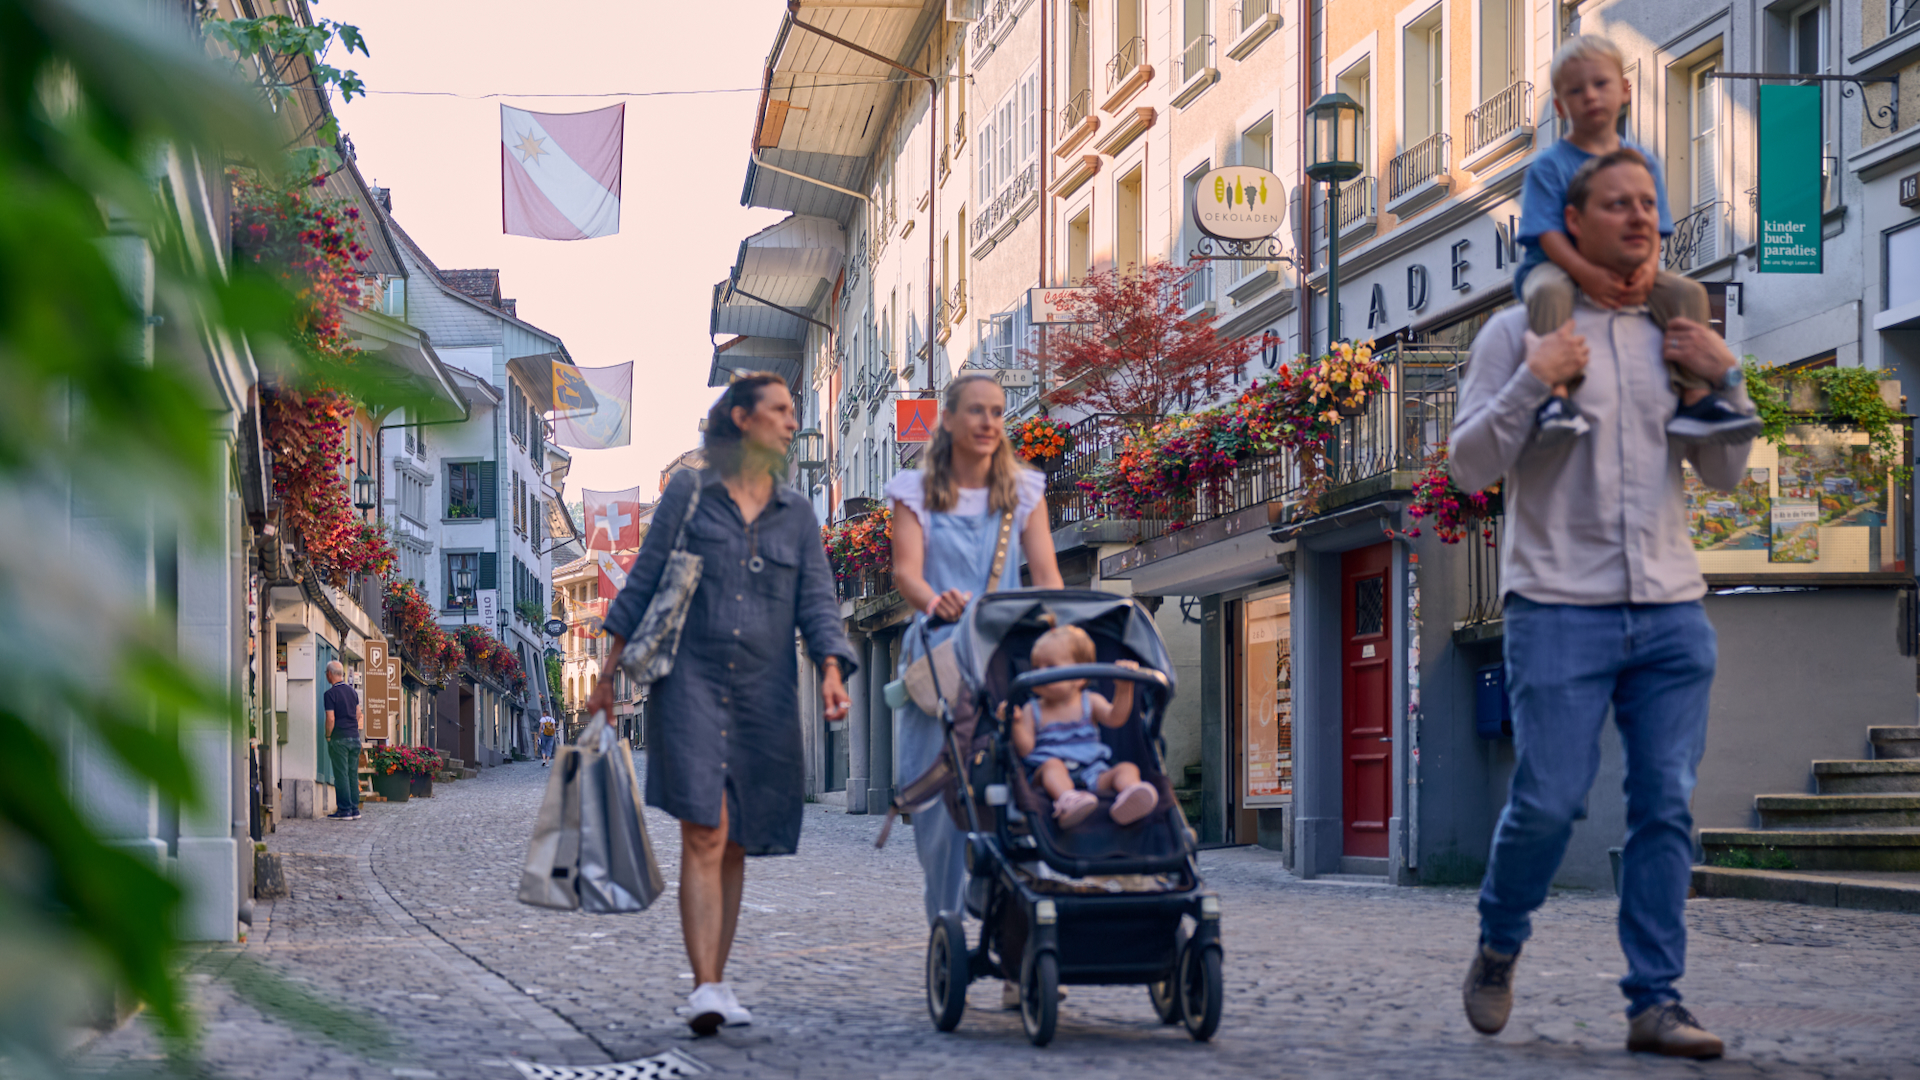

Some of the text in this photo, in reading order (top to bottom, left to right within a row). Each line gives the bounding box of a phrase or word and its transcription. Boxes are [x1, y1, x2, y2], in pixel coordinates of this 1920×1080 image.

[1903, 178, 1916, 199] 16
[1205, 212, 1278, 223] OEKOLADEN
[1764, 220, 1806, 232] kinder
[1764, 232, 1793, 244] buch
[1764, 244, 1817, 258] paradies
[1801, 510, 1816, 518] Ferien
[373, 650, 380, 664] P
